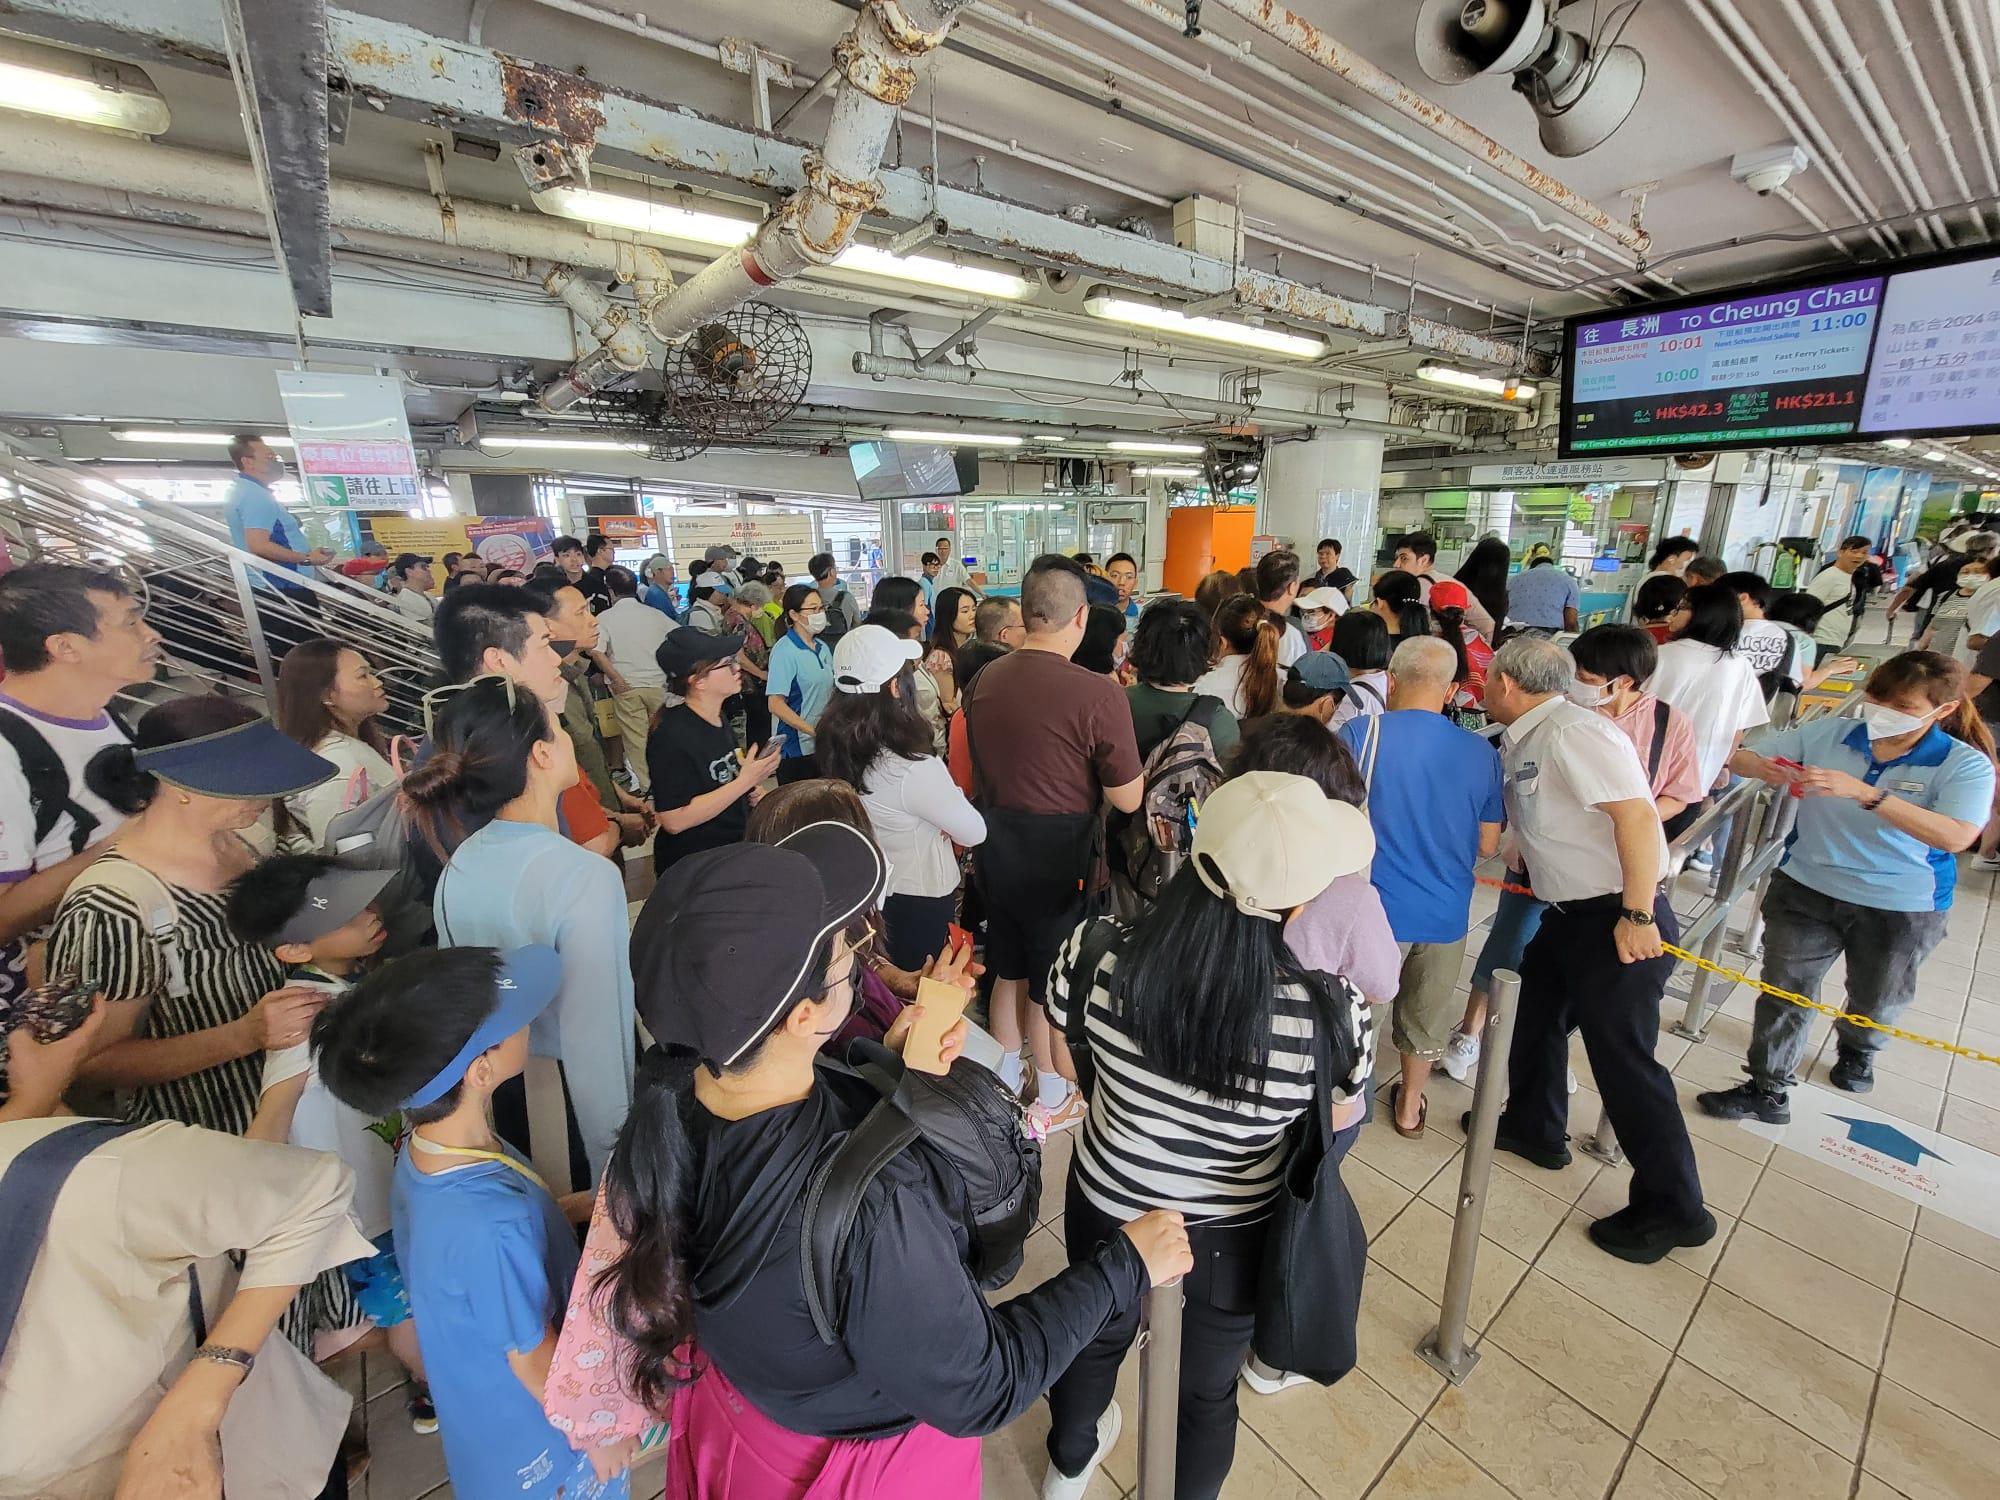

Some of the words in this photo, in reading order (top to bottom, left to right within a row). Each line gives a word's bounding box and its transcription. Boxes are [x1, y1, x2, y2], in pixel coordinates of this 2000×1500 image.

[1583, 328, 1600, 344] 往
[1620, 315, 1661, 338] 長洲
[1680, 315, 1702, 329] TO
[1708, 299, 1800, 325] Cheung
[1807, 286, 1876, 310] Chau
[1810, 312, 1868, 333] 11:00
[1659, 335, 1702, 353] 10:01
[1774, 352, 1793, 361] Fast
[1795, 348, 1818, 360] Ferry
[1819, 345, 1850, 356] Tickets
[1655, 367, 1699, 384] 10:00
[1791, 365, 1810, 374] Than
[1775, 390, 1856, 411] HK$21.1
[1655, 402, 1724, 420] HK$42.3
[350, 496, 377, 505] Please
[378, 497, 388, 506] go
[730, 530, 763, 538] Attention
[1819, 1144, 1848, 1158] FAST
[1851, 1157, 1891, 1176] FERRY
[1893, 1175, 1938, 1197] (CASH)
